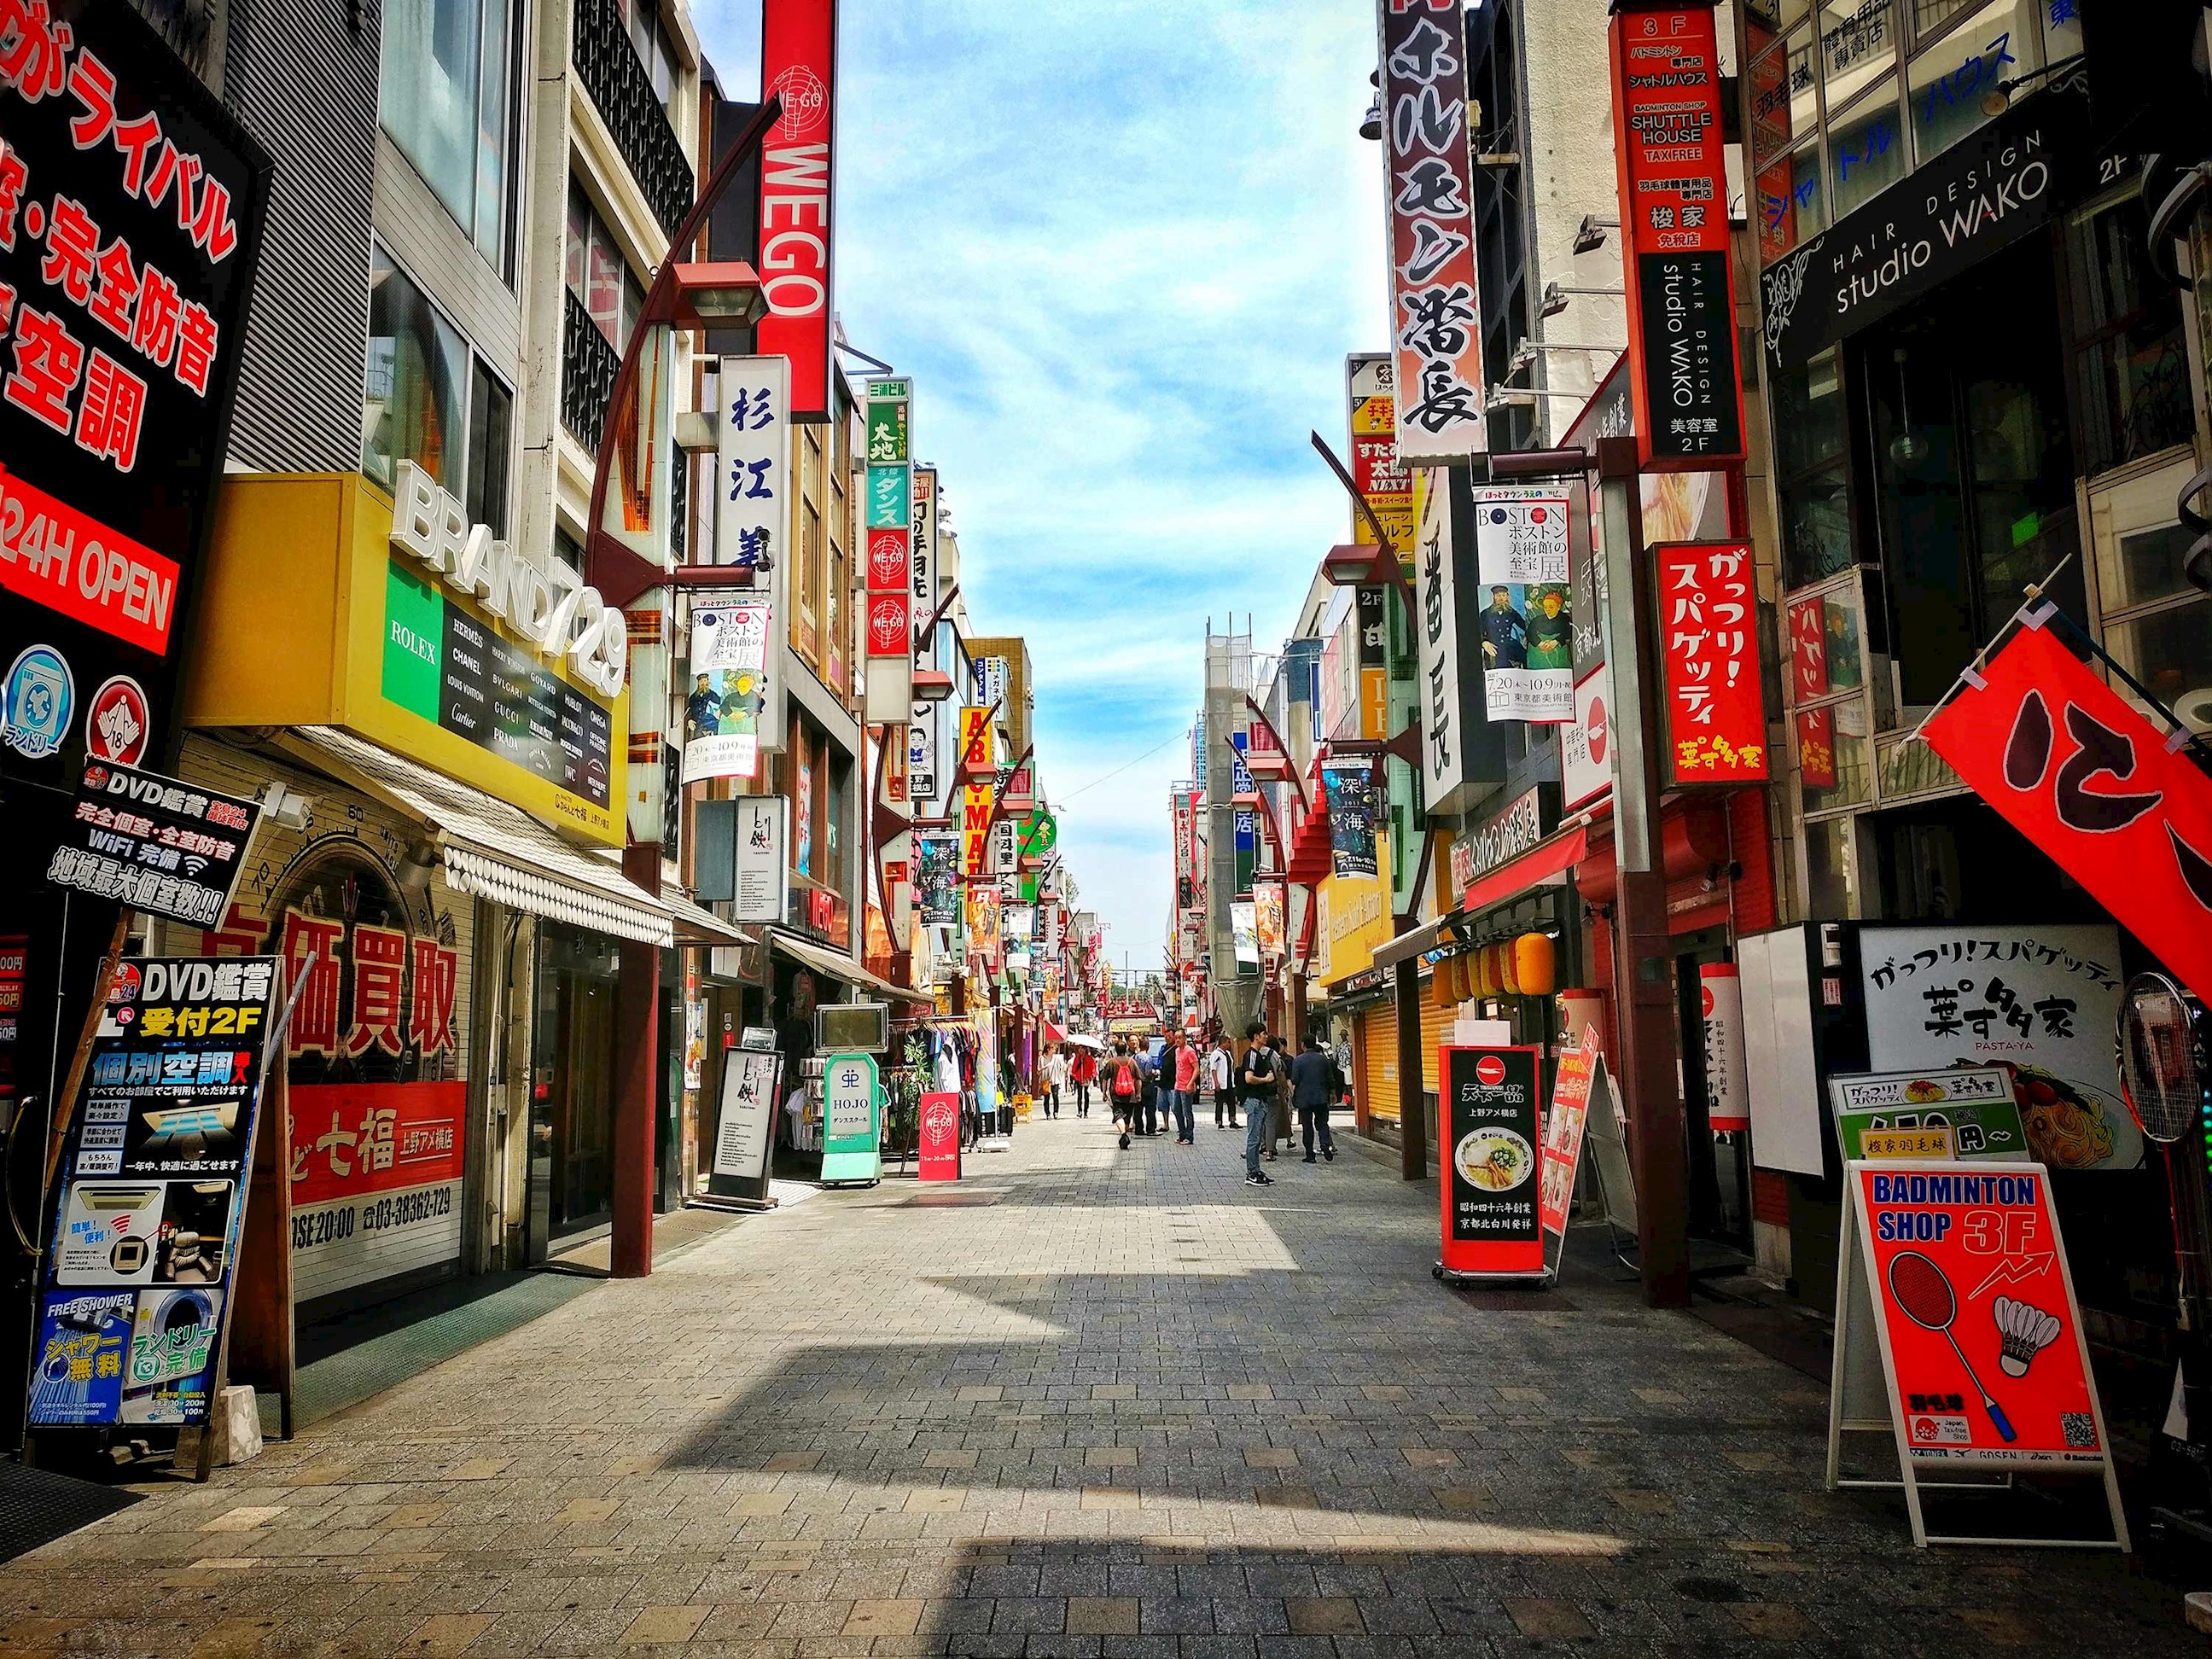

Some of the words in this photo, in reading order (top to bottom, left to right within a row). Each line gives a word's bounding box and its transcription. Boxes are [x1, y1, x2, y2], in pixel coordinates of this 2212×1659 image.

[1631, 45, 1682, 59] バドミントン
[1628, 71, 1708, 89] シャトルハウス
[1631, 112, 1712, 130] SHUTTLE
[1634, 103, 1683, 113] BADMINTON
[1684, 102, 1707, 111] SHOP
[1642, 129, 1703, 145] HOUSE
[1644, 149, 1671, 162] TAX
[1673, 148, 1703, 161] FREE
[1832, 222, 1895, 274] HAIR
[1925, 130, 2043, 216] DESIGN
[763, 141, 829, 317] WEGO
[1388, 16, 1479, 434] ホルモン番長
[1836, 239, 1931, 314] studio
[1939, 161, 2048, 248] WAKO
[1662, 265, 1687, 334] studio
[1690, 262, 1704, 310] HAIR
[0, 286, 148, 473] 空調
[1669, 338, 1694, 407] WAKO
[1695, 329, 1712, 405] DESIGN
[1669, 417, 1719, 434] 美容室
[1368, 478, 1411, 492] NEXT
[876, 477, 902, 526] ダンス
[1508, 525, 1568, 541] ボストン
[1508, 541, 1568, 556] 美術館の
[79, 540, 172, 631] OPEN
[715, 625, 765, 637] ボストン
[1708, 547, 1748, 688] がっつり!
[390, 619, 437, 667] ROLEX
[715, 637, 764, 649] 美術館の
[1668, 563, 1715, 725] スパゲッティ
[452, 647, 482, 676] CHANEL
[529, 671, 557, 696] GOYARD
[1514, 692, 1573, 703] 東京都美術館
[494, 701, 520, 725] GUCCI
[5, 724, 60, 754] ランドリー
[111, 731, 122, 749] 18
[493, 726, 519, 752] PRADA
[106, 771, 208, 818] DVD鑑賞
[75, 801, 236, 862] 完全個室・全室防音
[141, 963, 273, 1002] DVD鑑賞
[138, 1006, 262, 1037] 受付2F
[1975, 1040, 2035, 1051] PASTA-YA
[91, 1051, 235, 1086] 個別空調
[833, 1098, 869, 1109] HOJO
[1850, 1084, 1898, 1098] がっつり!
[1468, 1108, 1518, 1118] 上野アメ横店
[400, 1126, 454, 1155] 上野アメ横店
[1872, 1173, 2036, 1206] BADMINTON
[1459, 1202, 1532, 1214] 昭和四十六年創業
[1877, 1210, 1953, 1242] SHOP
[1962, 1209, 2038, 1255] 3F
[47, 1301, 79, 1318] FREE
[79, 1292, 134, 1313] SHOWER
[44, 1333, 123, 1362] シャワー
[131, 1323, 218, 1356] ランドリー
[68, 1351, 122, 1383] 無料
[164, 1347, 208, 1376] 完備
[1953, 1433, 1969, 1441] Shop
